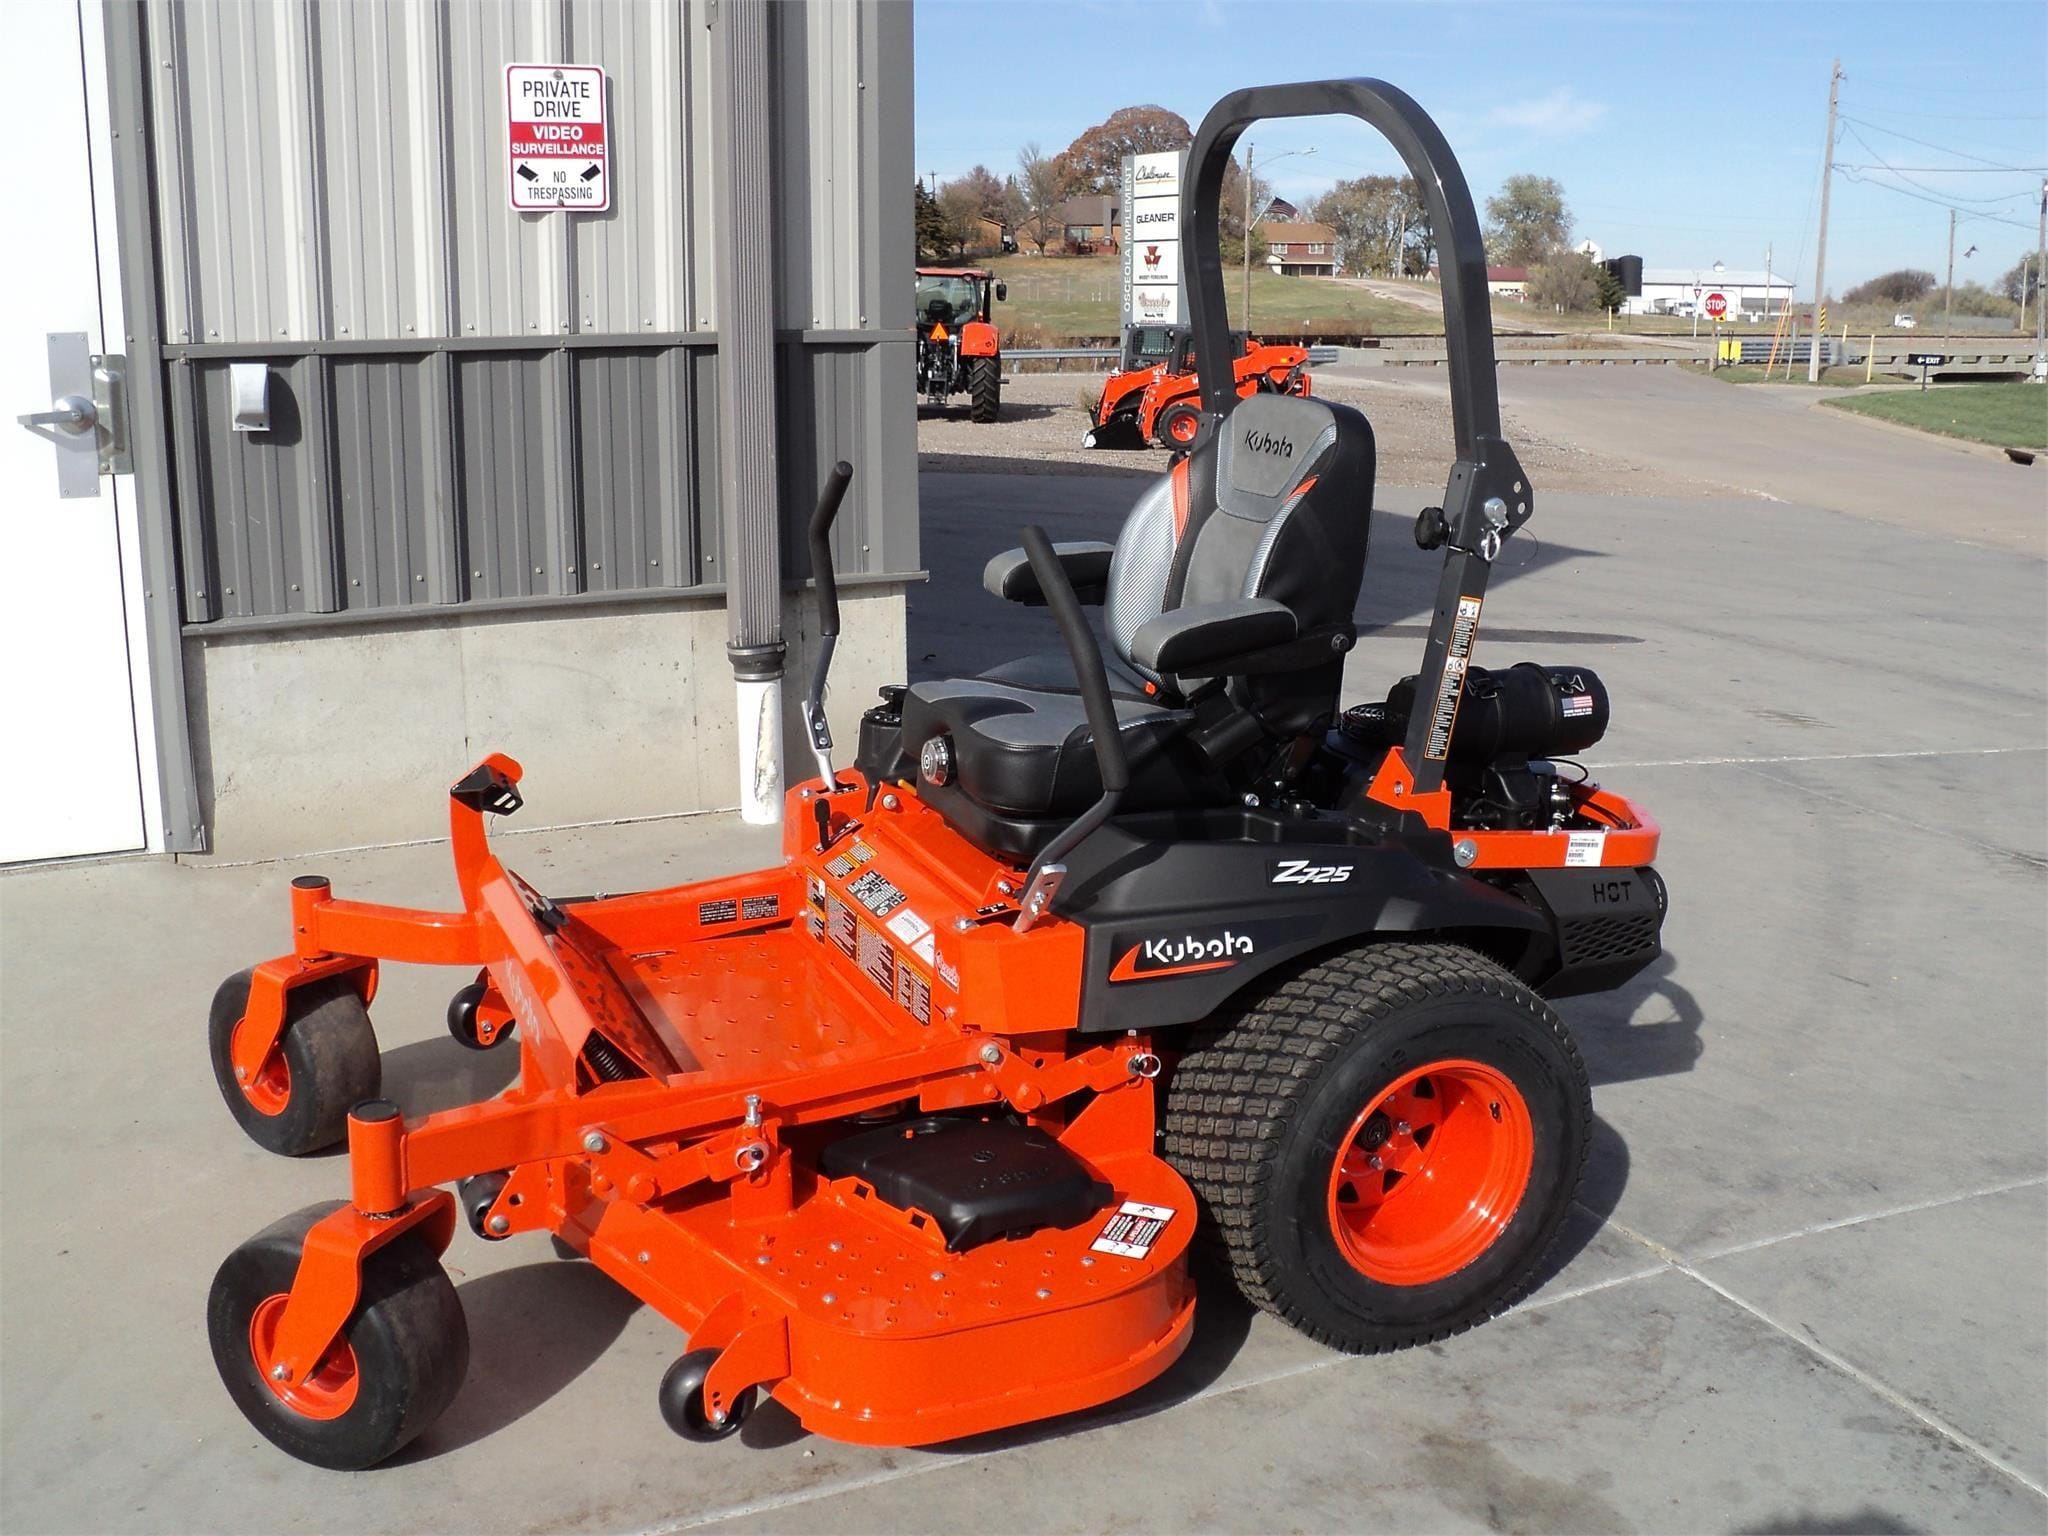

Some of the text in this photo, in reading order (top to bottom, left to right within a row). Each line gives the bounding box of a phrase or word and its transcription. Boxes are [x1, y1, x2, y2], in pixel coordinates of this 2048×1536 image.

[523, 81, 590, 98] PRIVATE
[534, 101, 581, 118] DRIVE
[532, 125, 583, 140] VIDEO
[512, 143, 604, 155] SURVEILLANCE
[553, 171, 567, 183] NO
[528, 186, 593, 200] TRESPASSING
[1136, 213, 1175, 224] GLEANER
[1123, 166, 1132, 312] OSCEOLA IMPLEMENT
[1706, 300, 1726, 310] STOP
[1245, 429, 1293, 458] Kubota
[1272, 860, 1354, 884] Z725
[1593, 881, 1631, 903] HOT
[1145, 931, 1254, 963] Kubota
